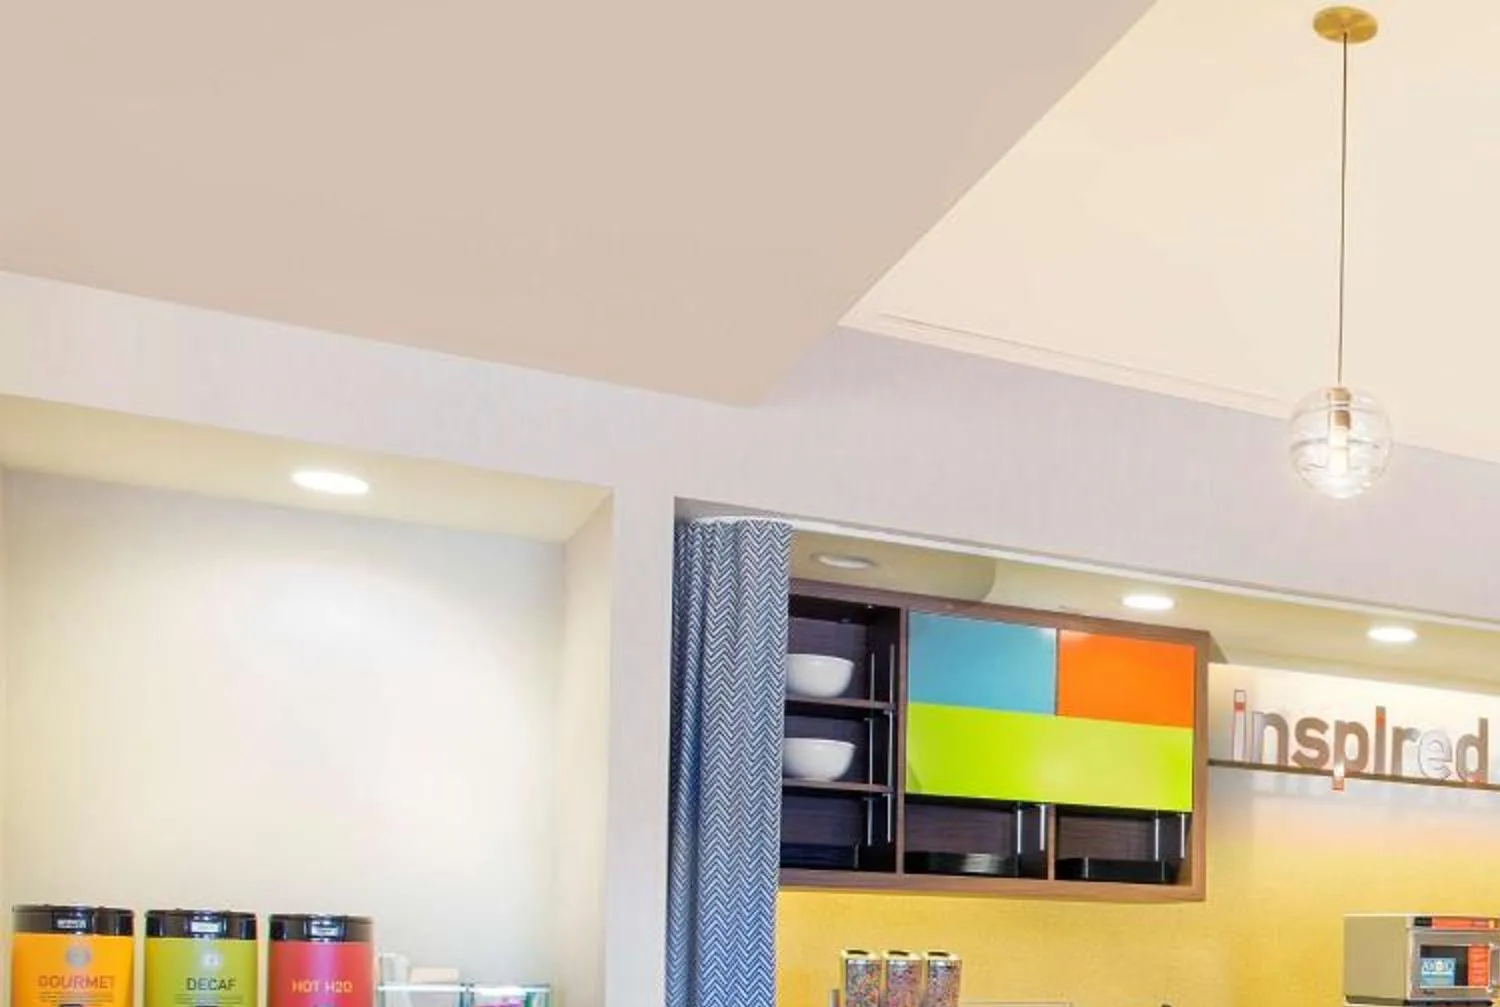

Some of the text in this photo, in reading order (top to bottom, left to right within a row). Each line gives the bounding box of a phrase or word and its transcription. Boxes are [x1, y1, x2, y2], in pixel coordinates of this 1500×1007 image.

[1231, 690, 1489, 791] inspired
[38, 975, 116, 990] GOURMET
[187, 977, 236, 991] DECAF
[292, 979, 319, 992] HOT
